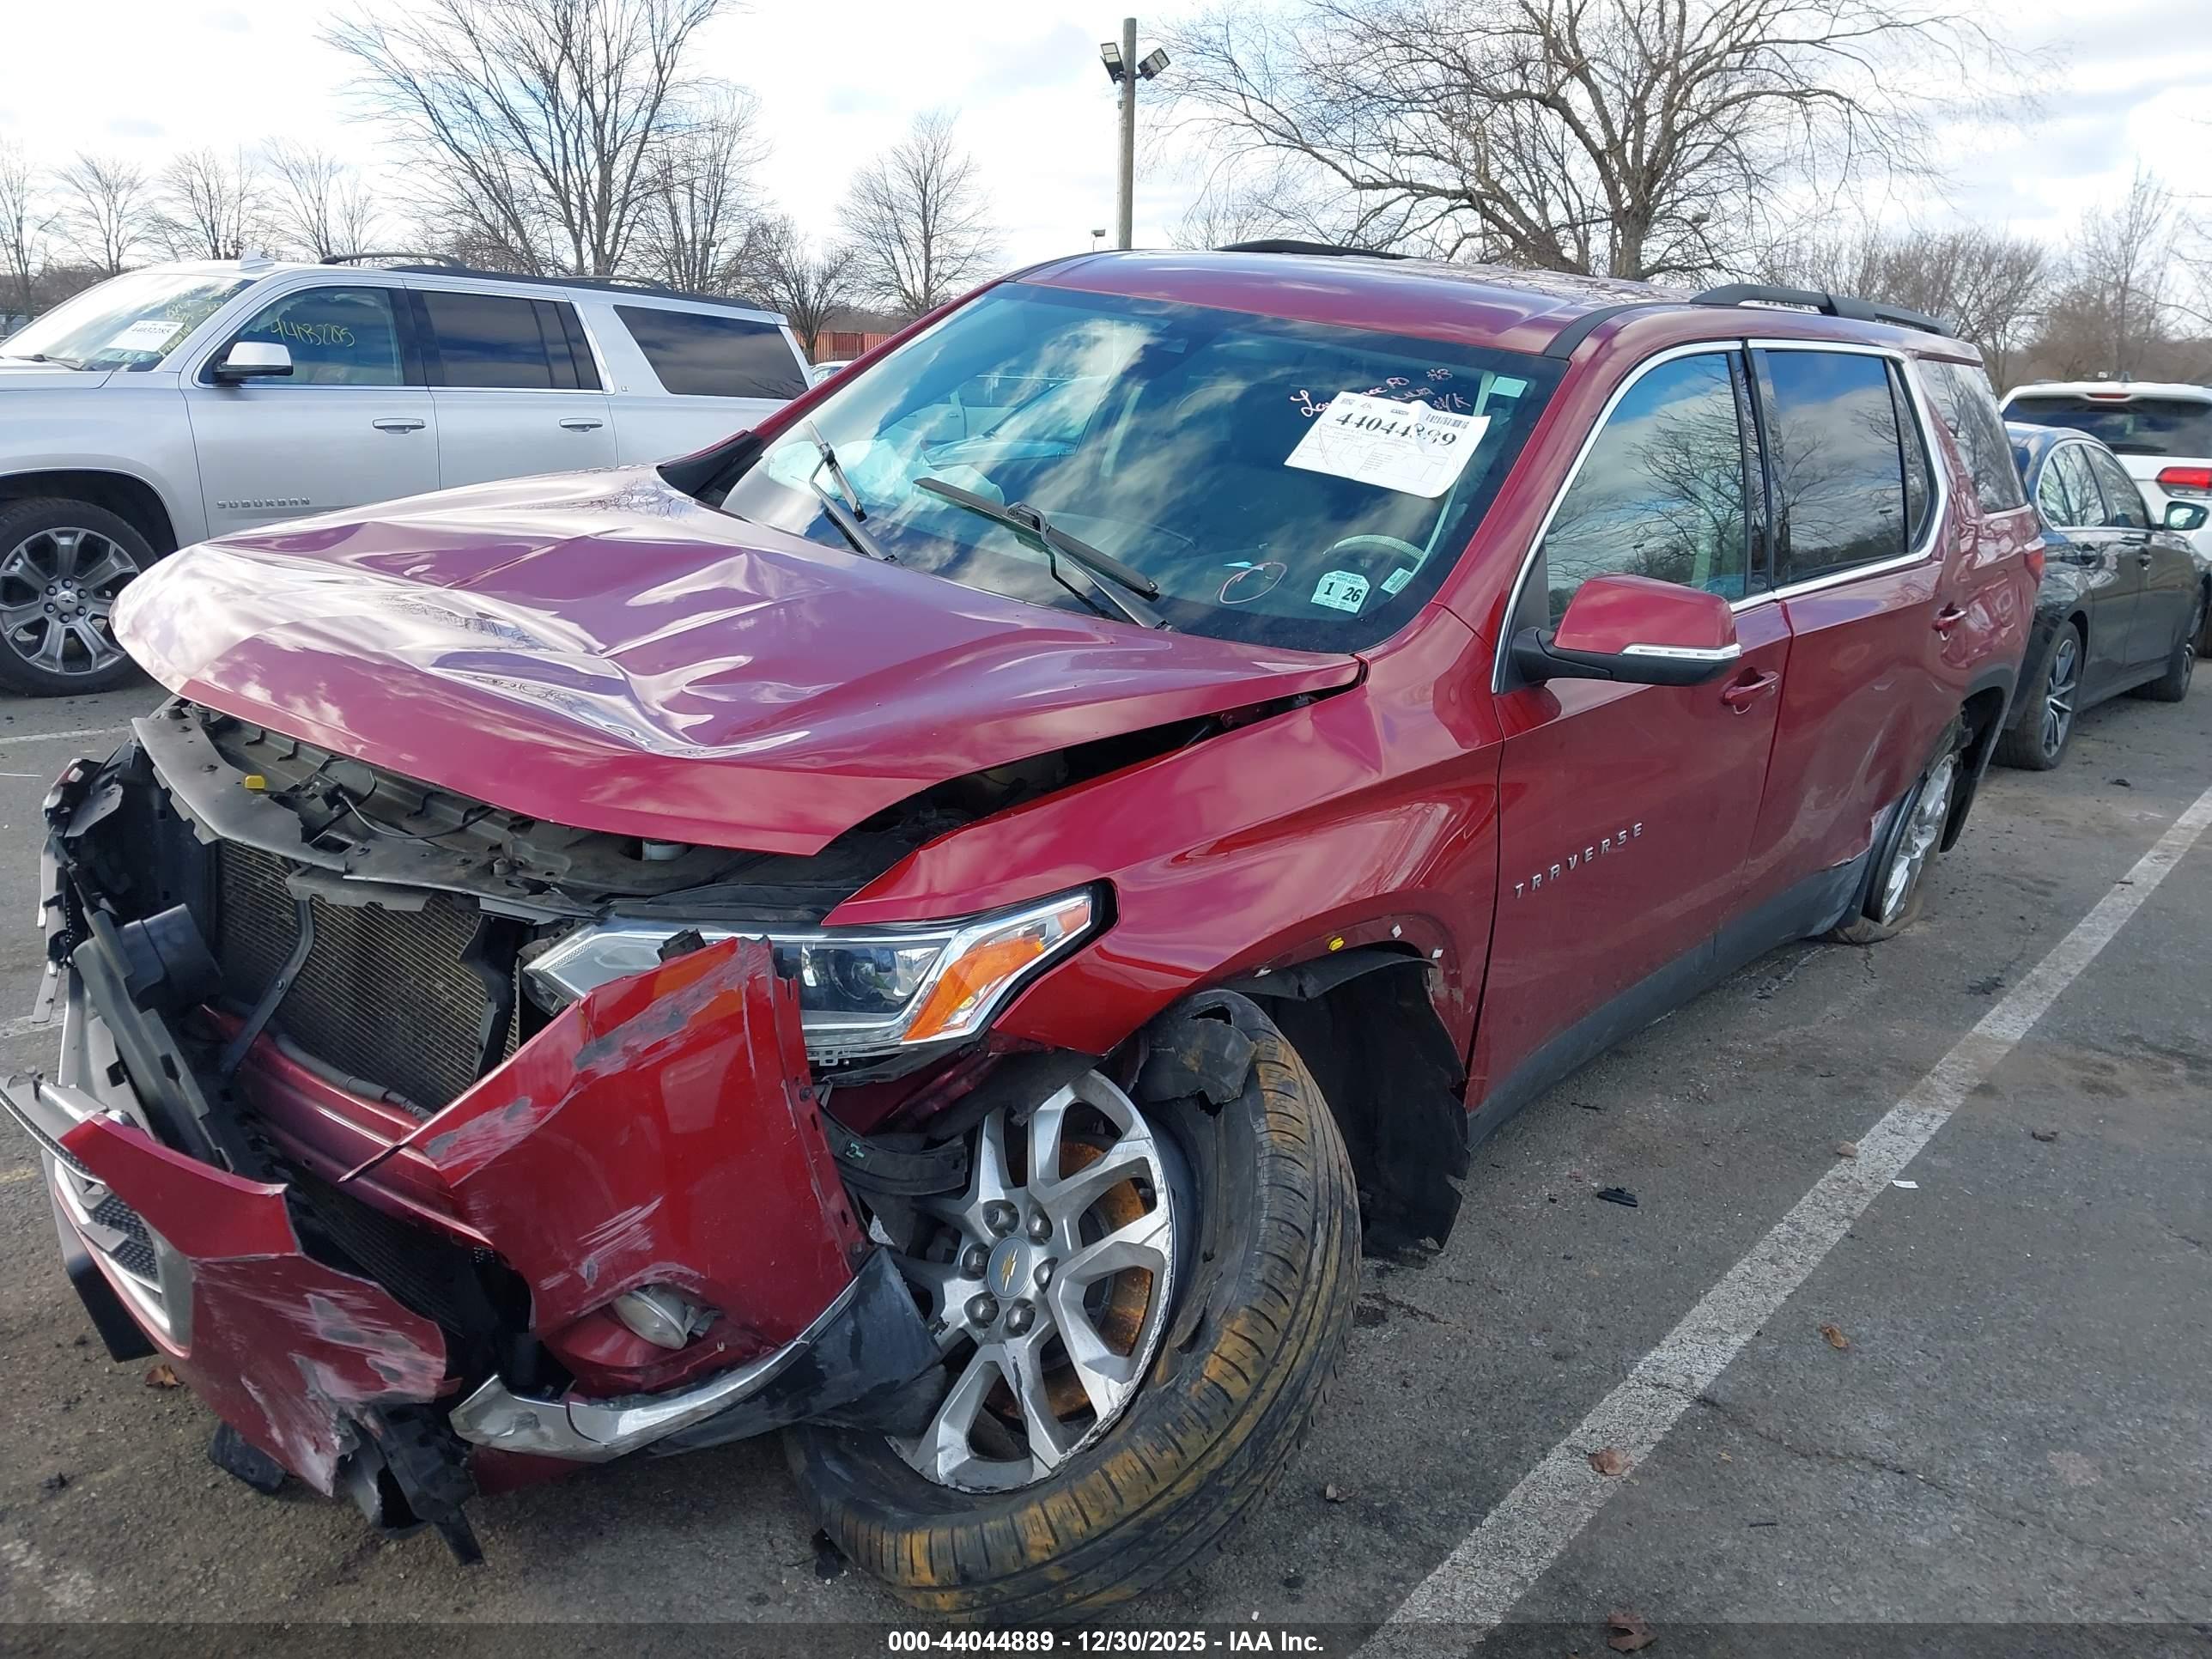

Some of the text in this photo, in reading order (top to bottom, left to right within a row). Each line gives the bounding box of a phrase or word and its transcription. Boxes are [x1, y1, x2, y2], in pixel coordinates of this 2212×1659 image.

[216, 496, 311, 509] SUBURBAN
[1323, 581, 1363, 602] 1 26
[1513, 821, 1644, 900] TRAVERSE
